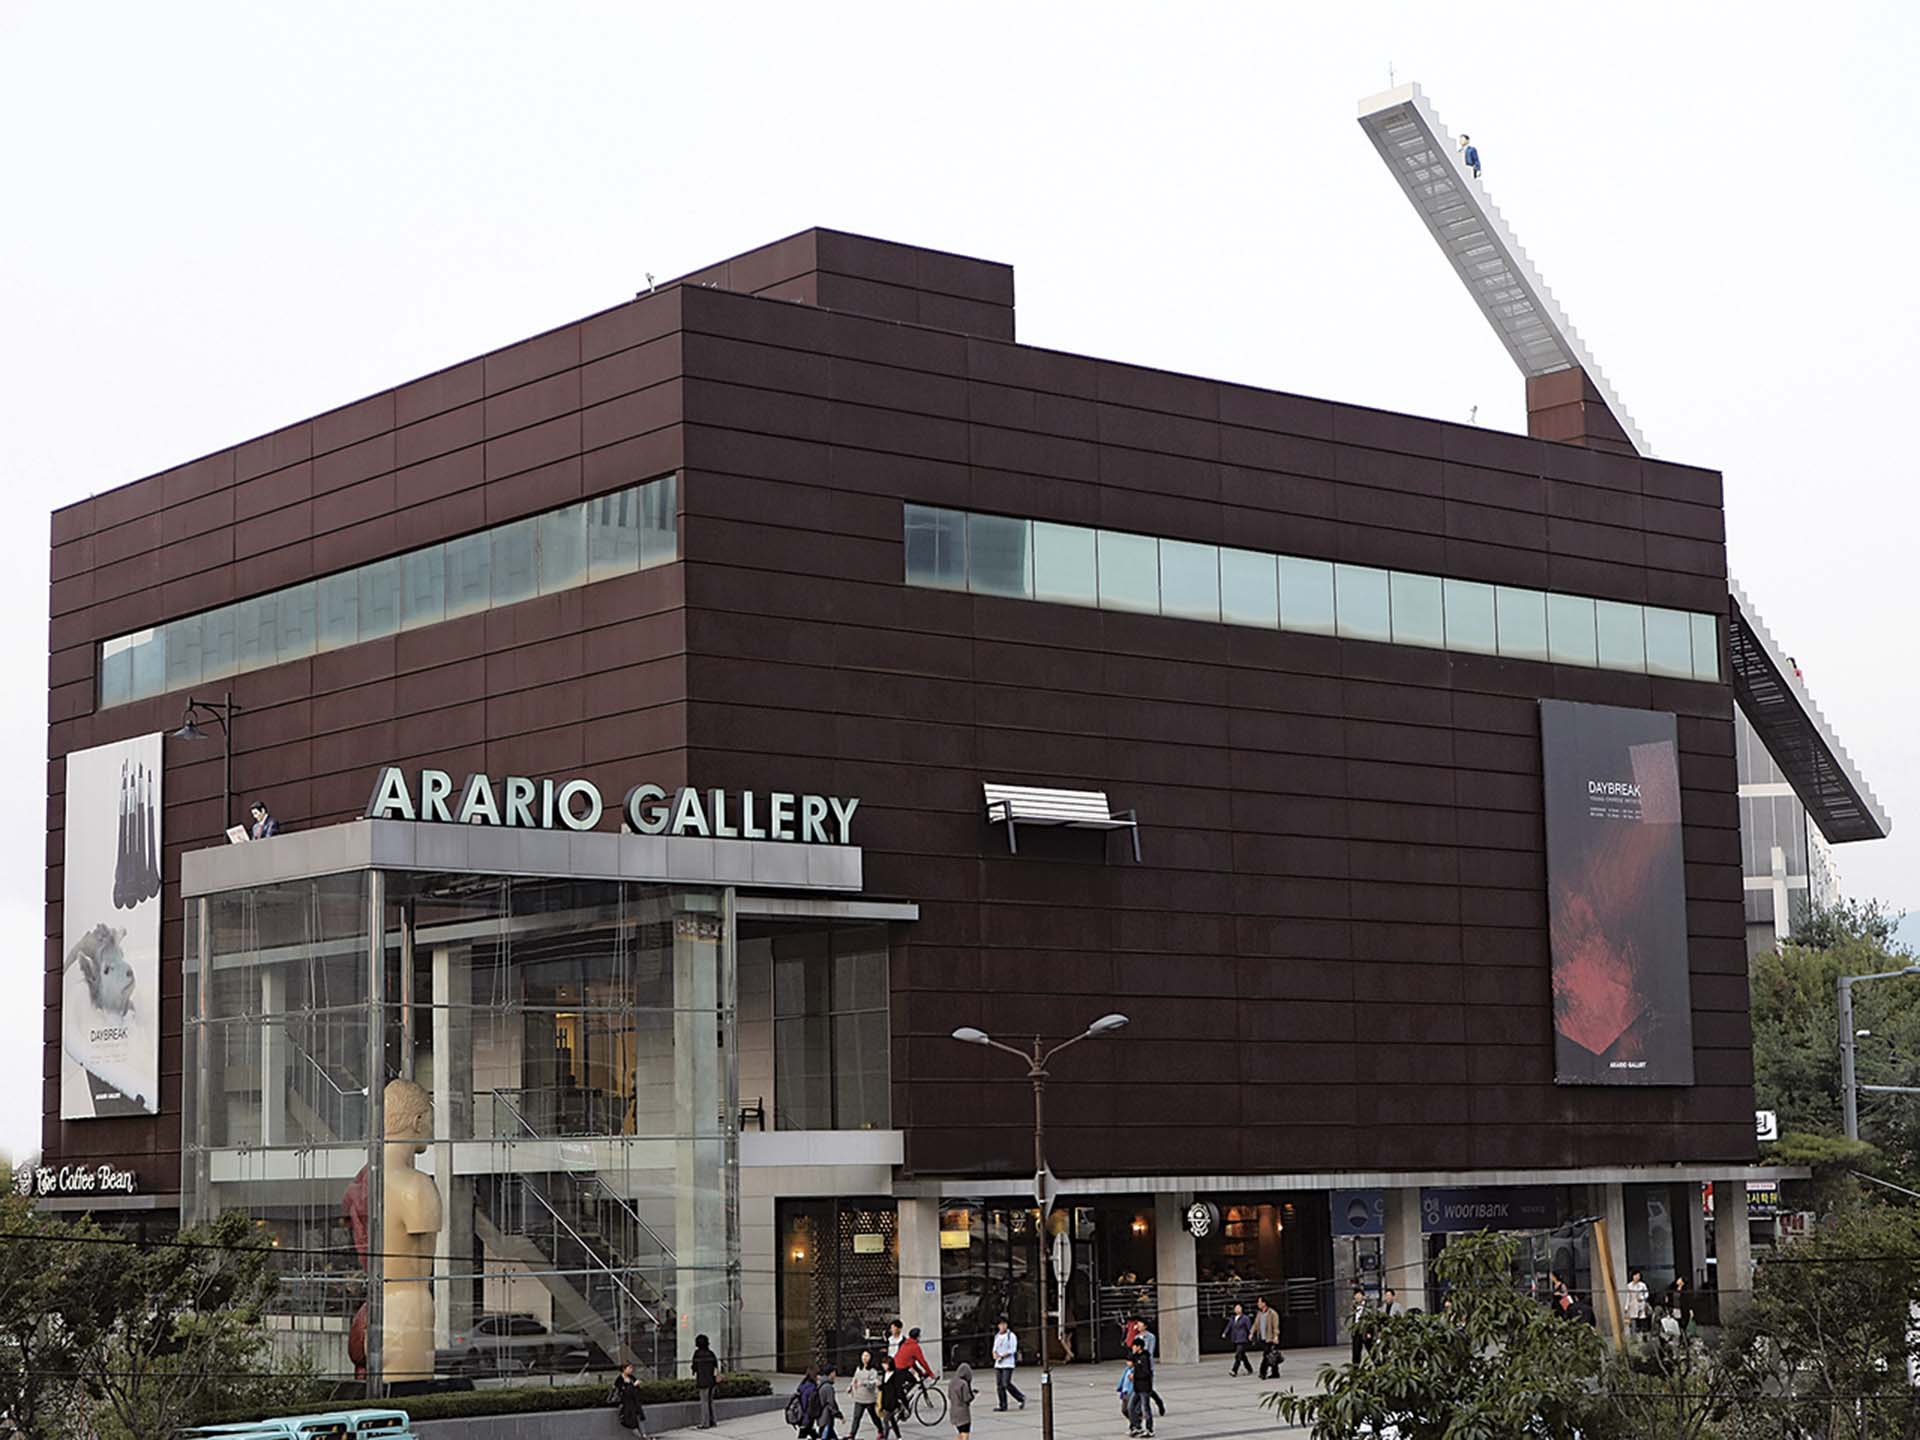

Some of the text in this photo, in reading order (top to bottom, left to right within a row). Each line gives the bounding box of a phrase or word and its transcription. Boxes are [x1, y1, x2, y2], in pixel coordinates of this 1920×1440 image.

[1588, 781, 1641, 797] DAYBREAK
[372, 766, 860, 844] ARARIO GALLERY
[90, 1027, 128, 1042] DAYBREAK
[35, 1165, 133, 1195] The Coffee Bean
